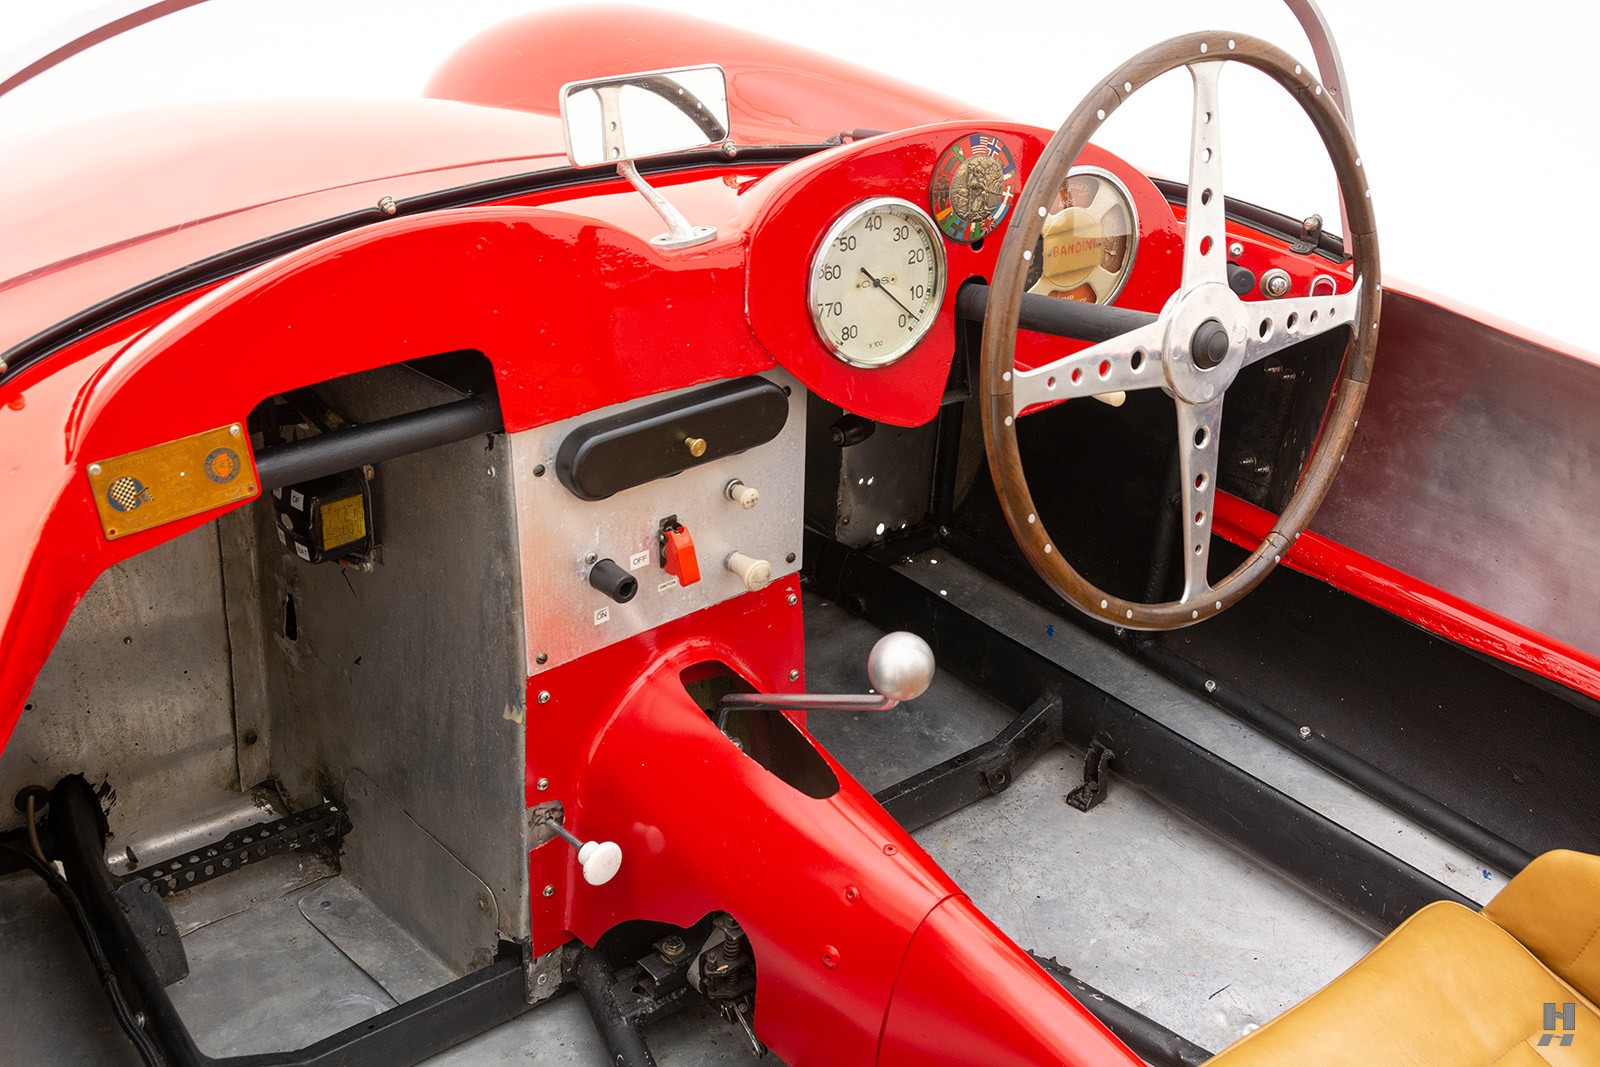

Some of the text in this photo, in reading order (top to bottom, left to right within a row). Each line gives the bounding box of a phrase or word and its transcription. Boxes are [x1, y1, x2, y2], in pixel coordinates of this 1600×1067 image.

[865, 215, 882, 231] 40
[893, 225, 909, 242] 30
[839, 235, 857, 252] 50
[1052, 239, 1097, 258] BANDINI
[908, 248, 925, 265] 20
[910, 284, 924, 300] 10
[898, 313, 907, 328] 0
[841, 324, 858, 341] 80
[633, 554, 648, 565] OFF
[596, 610, 608, 621] ON
